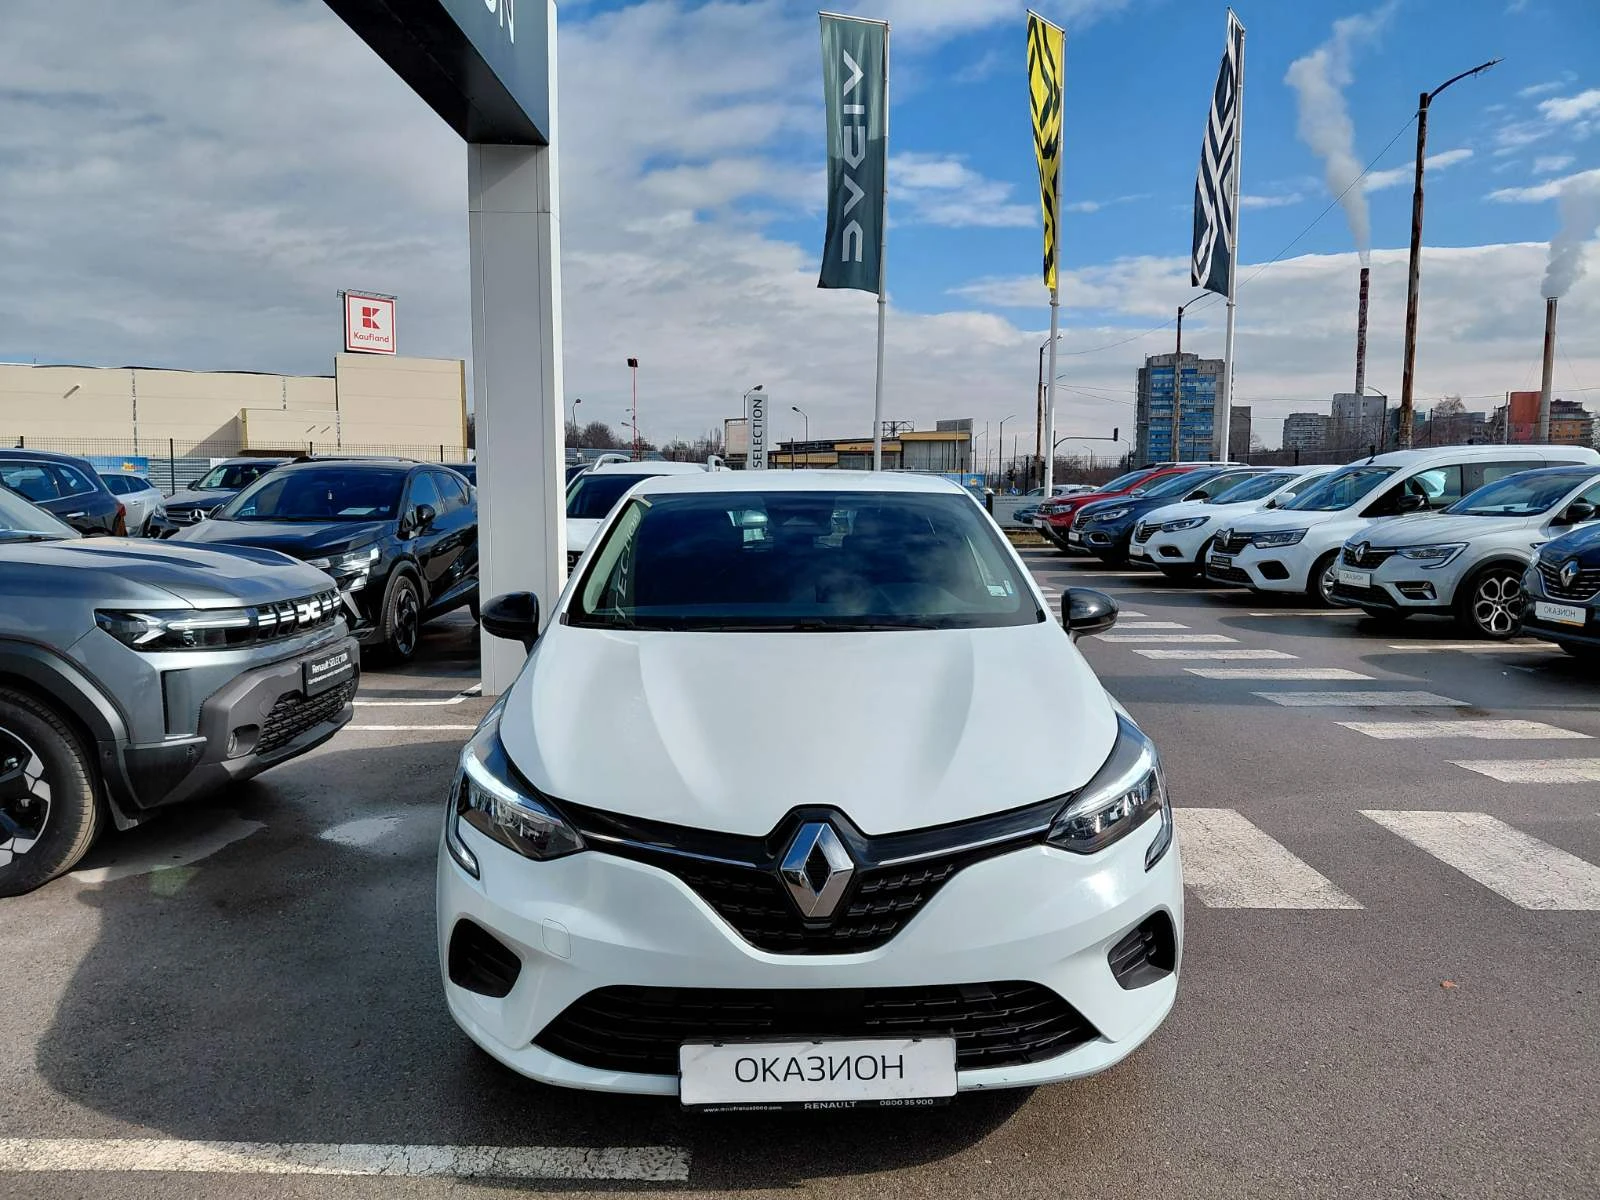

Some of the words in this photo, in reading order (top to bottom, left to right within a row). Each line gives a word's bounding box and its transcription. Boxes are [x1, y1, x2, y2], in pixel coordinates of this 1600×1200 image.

[353, 332, 389, 342] Kaufland
[752, 399, 763, 469] SELECTION
[1543, 605, 1576, 618] ОКАЗИОН
[735, 1054, 904, 1082] ОКАЗИОН
[804, 1101, 857, 1110] RENAULT
